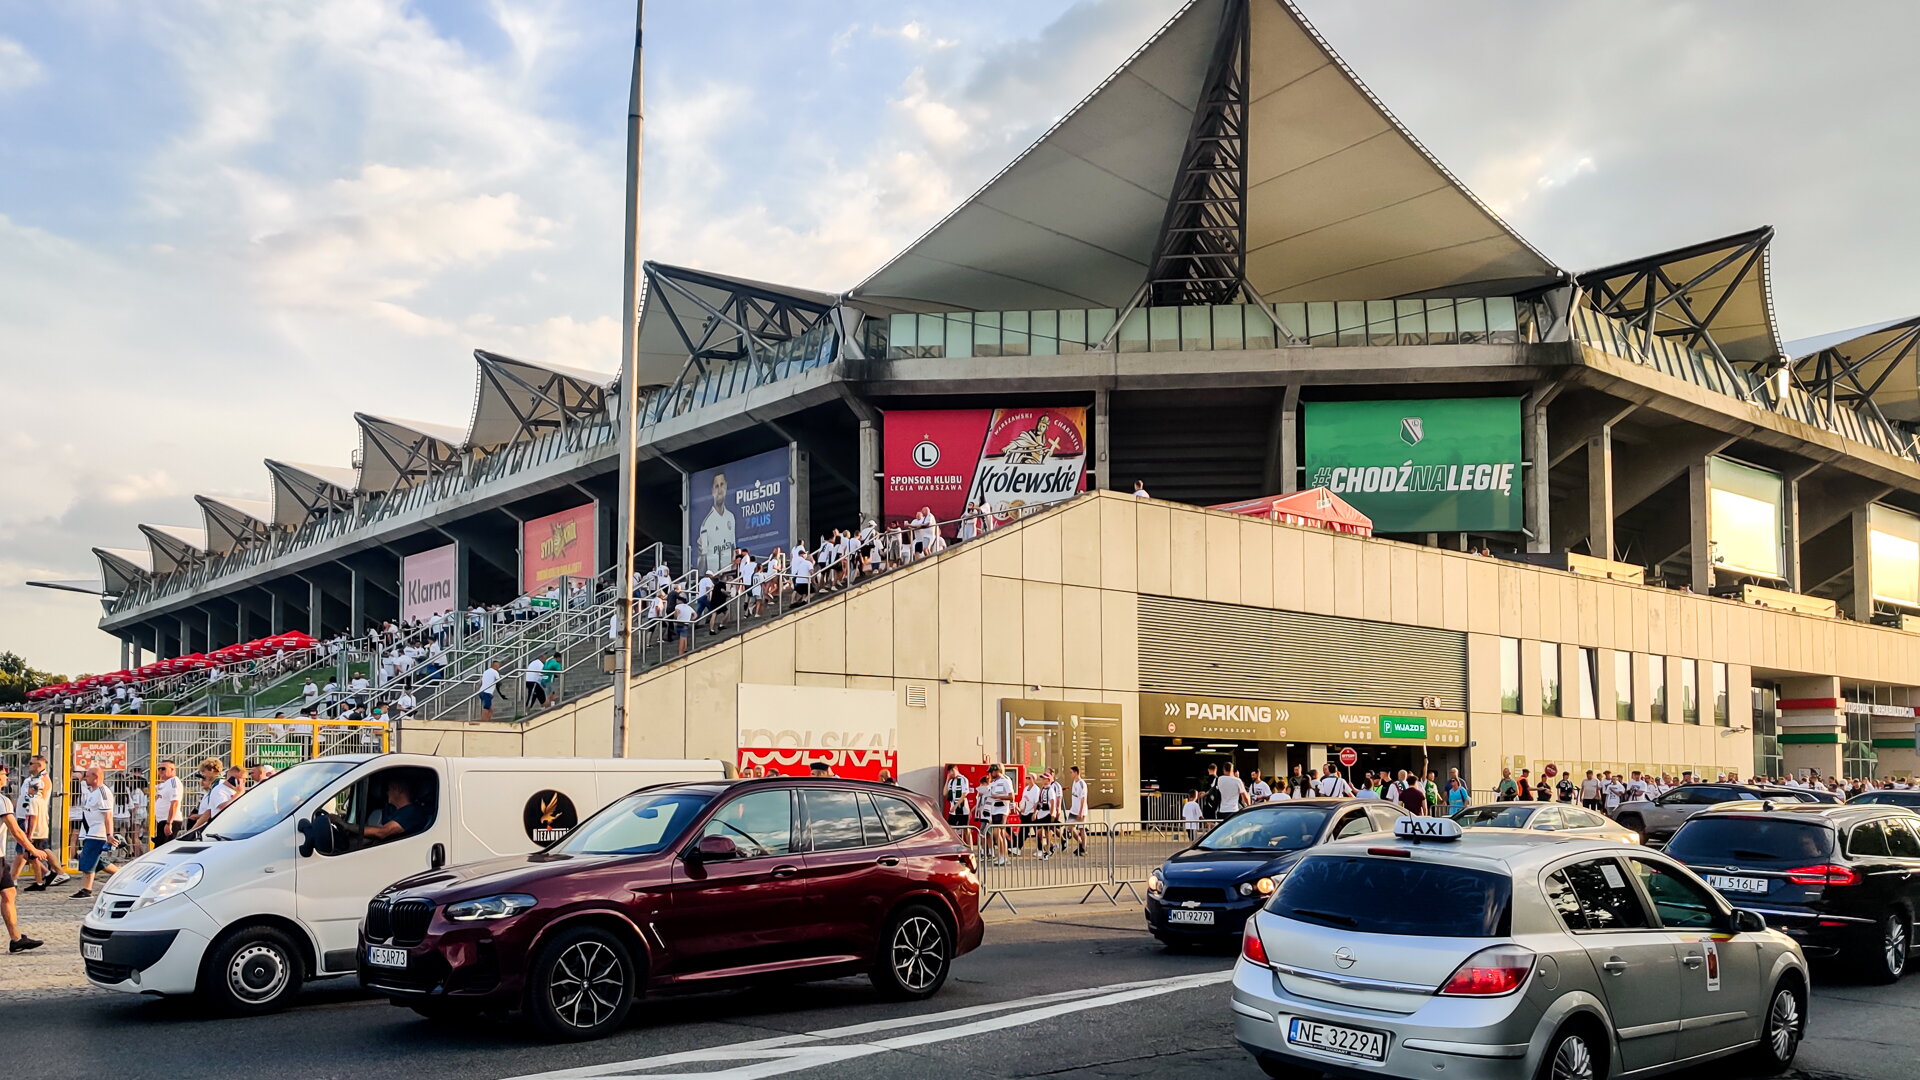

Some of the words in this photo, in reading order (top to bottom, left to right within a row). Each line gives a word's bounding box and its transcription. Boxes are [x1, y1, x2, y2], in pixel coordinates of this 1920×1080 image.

[994, 412, 1033, 436] WARSZAWSKI
[1053, 419, 1081, 452] CHARAKTER
[890, 476, 932, 485] SPONSOR
[933, 475, 963, 484] KLUBU
[973, 464, 1076, 499] Królewskie
[1312, 459, 1515, 496] #CHODŹNALEGIĘ
[736, 481, 781, 505] Plus500
[741, 500, 775, 518] TRADING
[751, 514, 771, 528] PLUS
[408, 577, 451, 607] Klarna
[1185, 702, 1272, 723] PARKING
[1339, 714, 1370, 724] WJAZD
[1372, 716, 1377, 724] 1
[1394, 723, 1419, 732] WJAZD
[1420, 724, 1425, 732] 2
[1430, 718, 1458, 728] WJAZD
[1458, 720, 1464, 728] 2
[1401, 820, 1443, 835] TAXI
[1709, 877, 1722, 887] WI
[1728, 878, 1765, 891] 516LF
[1172, 911, 1186, 920] WOT
[1189, 912, 1213, 921] 92797
[372, 948, 380, 963] WE
[1300, 1023, 1324, 1043] NE
[1329, 1029, 1379, 1055] 3229A
